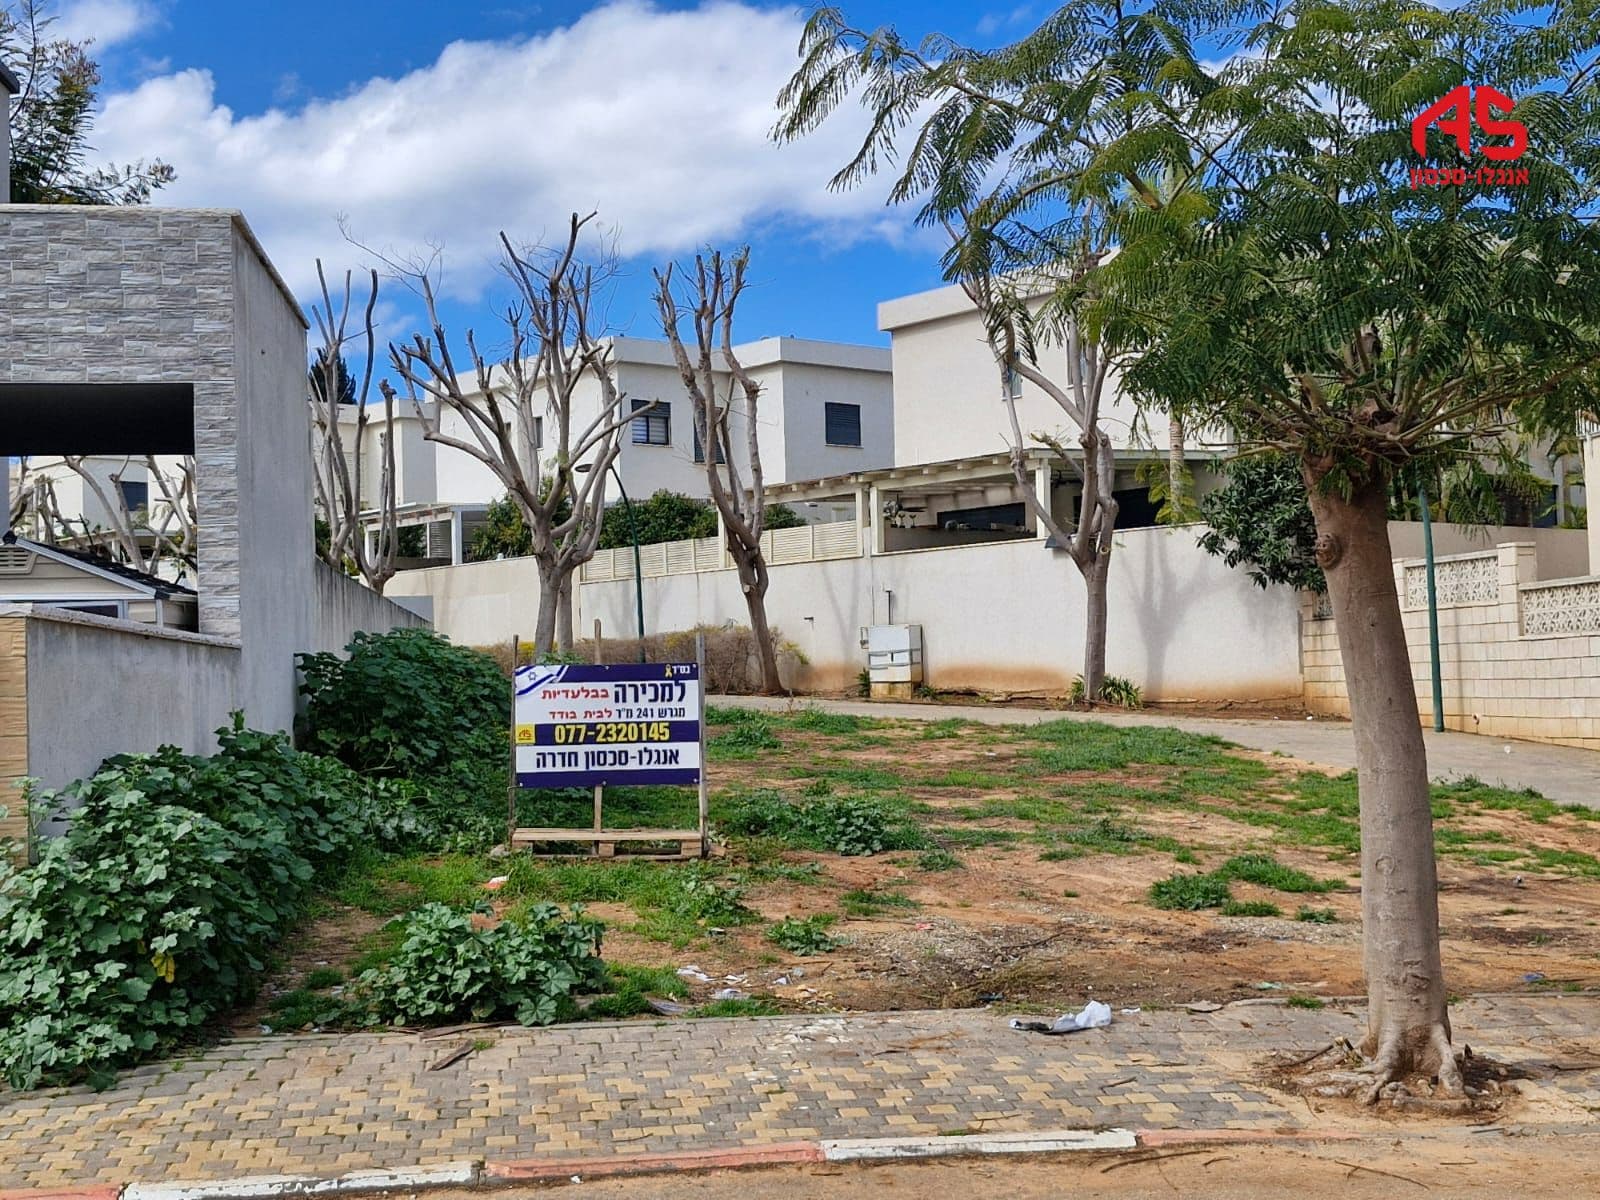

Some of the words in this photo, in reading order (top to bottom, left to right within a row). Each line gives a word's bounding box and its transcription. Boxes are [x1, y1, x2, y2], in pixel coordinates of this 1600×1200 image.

[541, 686, 609, 699] בבלעדיות
[614, 680, 686, 703] למכירה
[549, 710, 577, 719] בודד
[583, 707, 613, 719] לבית
[616, 708, 633, 719] מ"ר
[636, 707, 654, 719] 241
[658, 707, 686, 718] מגרש
[554, 722, 671, 743] 077-2320145
[536, 750, 579, 768] חדרה
[585, 747, 680, 770] אנגלו-סכסון
